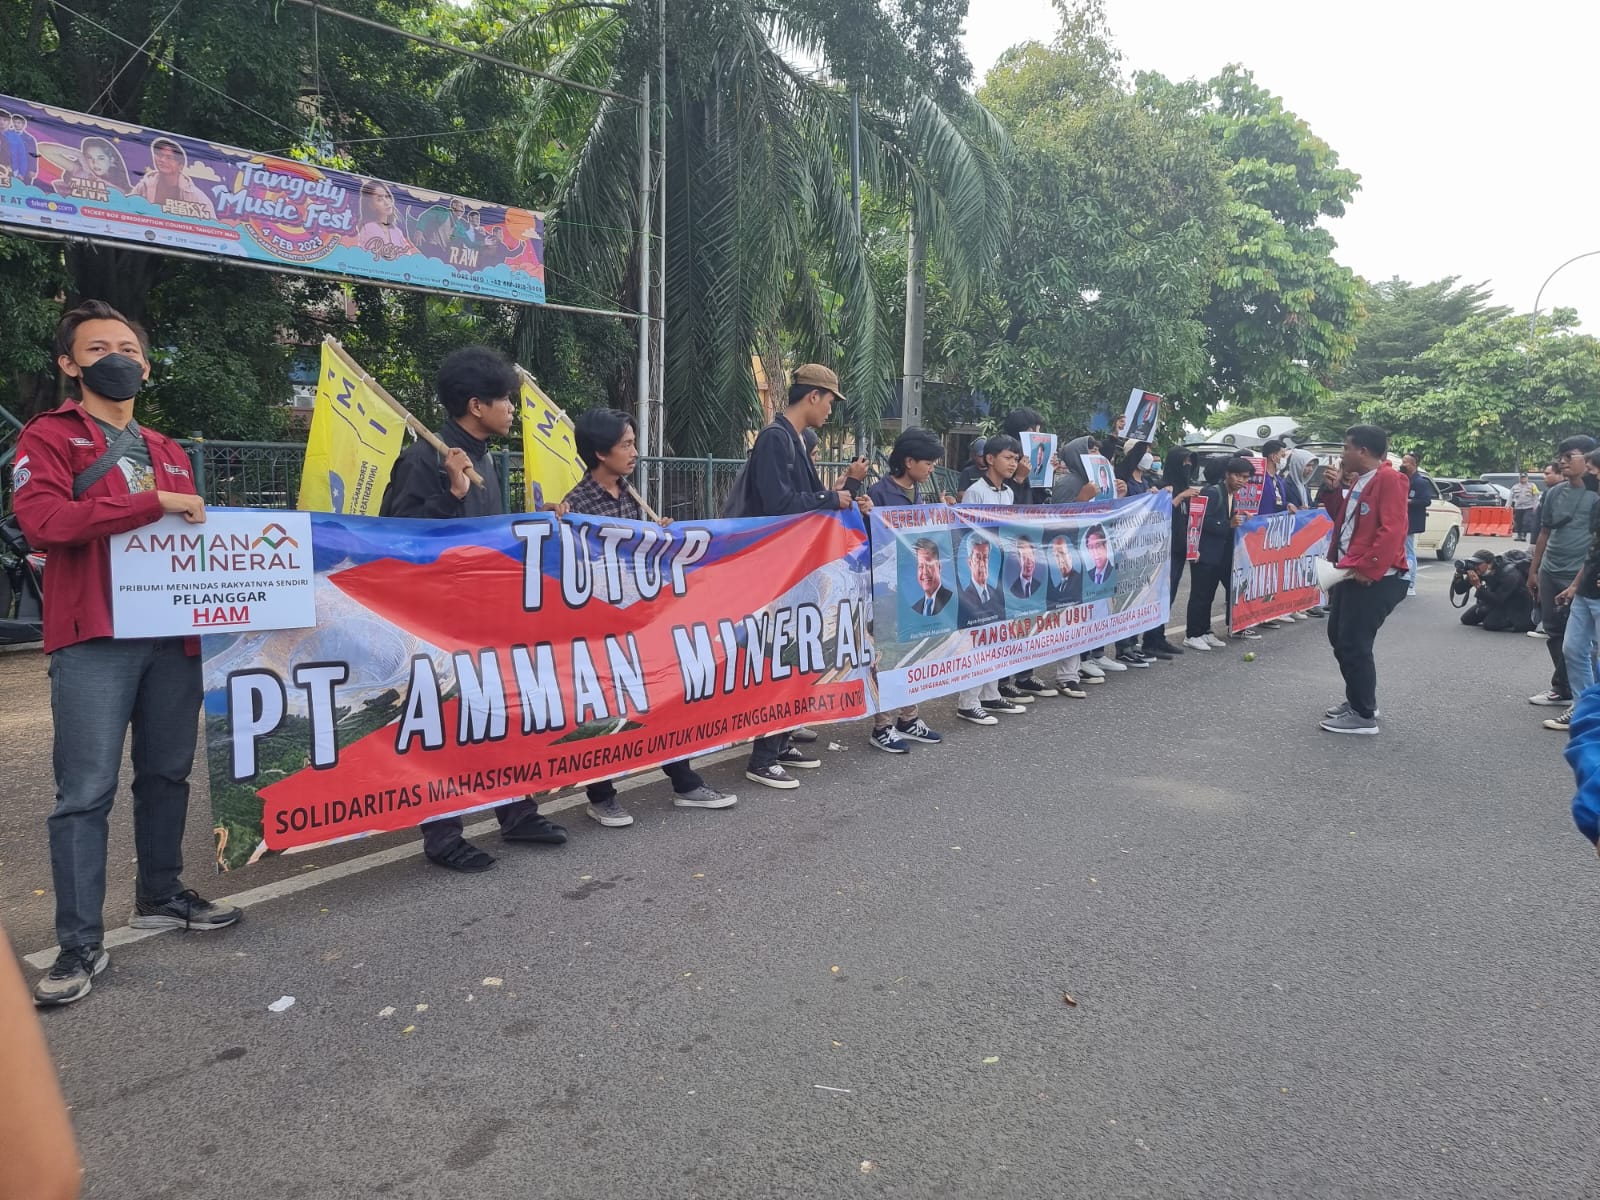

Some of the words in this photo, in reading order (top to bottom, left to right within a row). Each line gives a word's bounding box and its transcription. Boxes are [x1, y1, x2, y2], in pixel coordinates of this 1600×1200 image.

[236, 161, 347, 208] Tangcity
[211, 184, 298, 220] Music
[303, 203, 353, 231] Fest
[272, 235, 294, 252] FEB
[297, 235, 323, 252] 2023
[882, 508, 927, 529] MEREKA
[929, 506, 956, 526] YANG
[124, 534, 250, 553] AMMAN
[171, 552, 301, 573] MINERAL
[511, 519, 712, 612] TUTUP
[119, 584, 164, 592] PRIBUMI
[166, 582, 219, 591] MENINDAS
[221, 580, 274, 589] RAKYATNYA
[276, 579, 309, 587] SENDIRI
[173, 591, 267, 606] PELANGGAR
[192, 605, 250, 625] HAM
[970, 618, 1031, 649] TANGKAP
[1036, 612, 1061, 633] DAN
[1065, 604, 1094, 626] USUT
[907, 655, 972, 684] SOLIDARITAS
[973, 642, 1023, 666] MAHASISWA
[1025, 630, 1070, 653] TANGERANG
[1071, 623, 1092, 640] UNTUK
[1093, 618, 1109, 633] NUSA
[227, 661, 350, 784] PT
[394, 631, 650, 755] AMMAN
[671, 598, 873, 704] MINERAL
[275, 783, 423, 835] SOLIDARITAS
[427, 760, 543, 804] MAHASISWA
[547, 738, 644, 777] TANGERANG
[646, 731, 693, 754] UNTUK
[695, 718, 729, 744] NUSA
[731, 701, 793, 730] TENGGARA
[793, 691, 836, 715] BARAT
